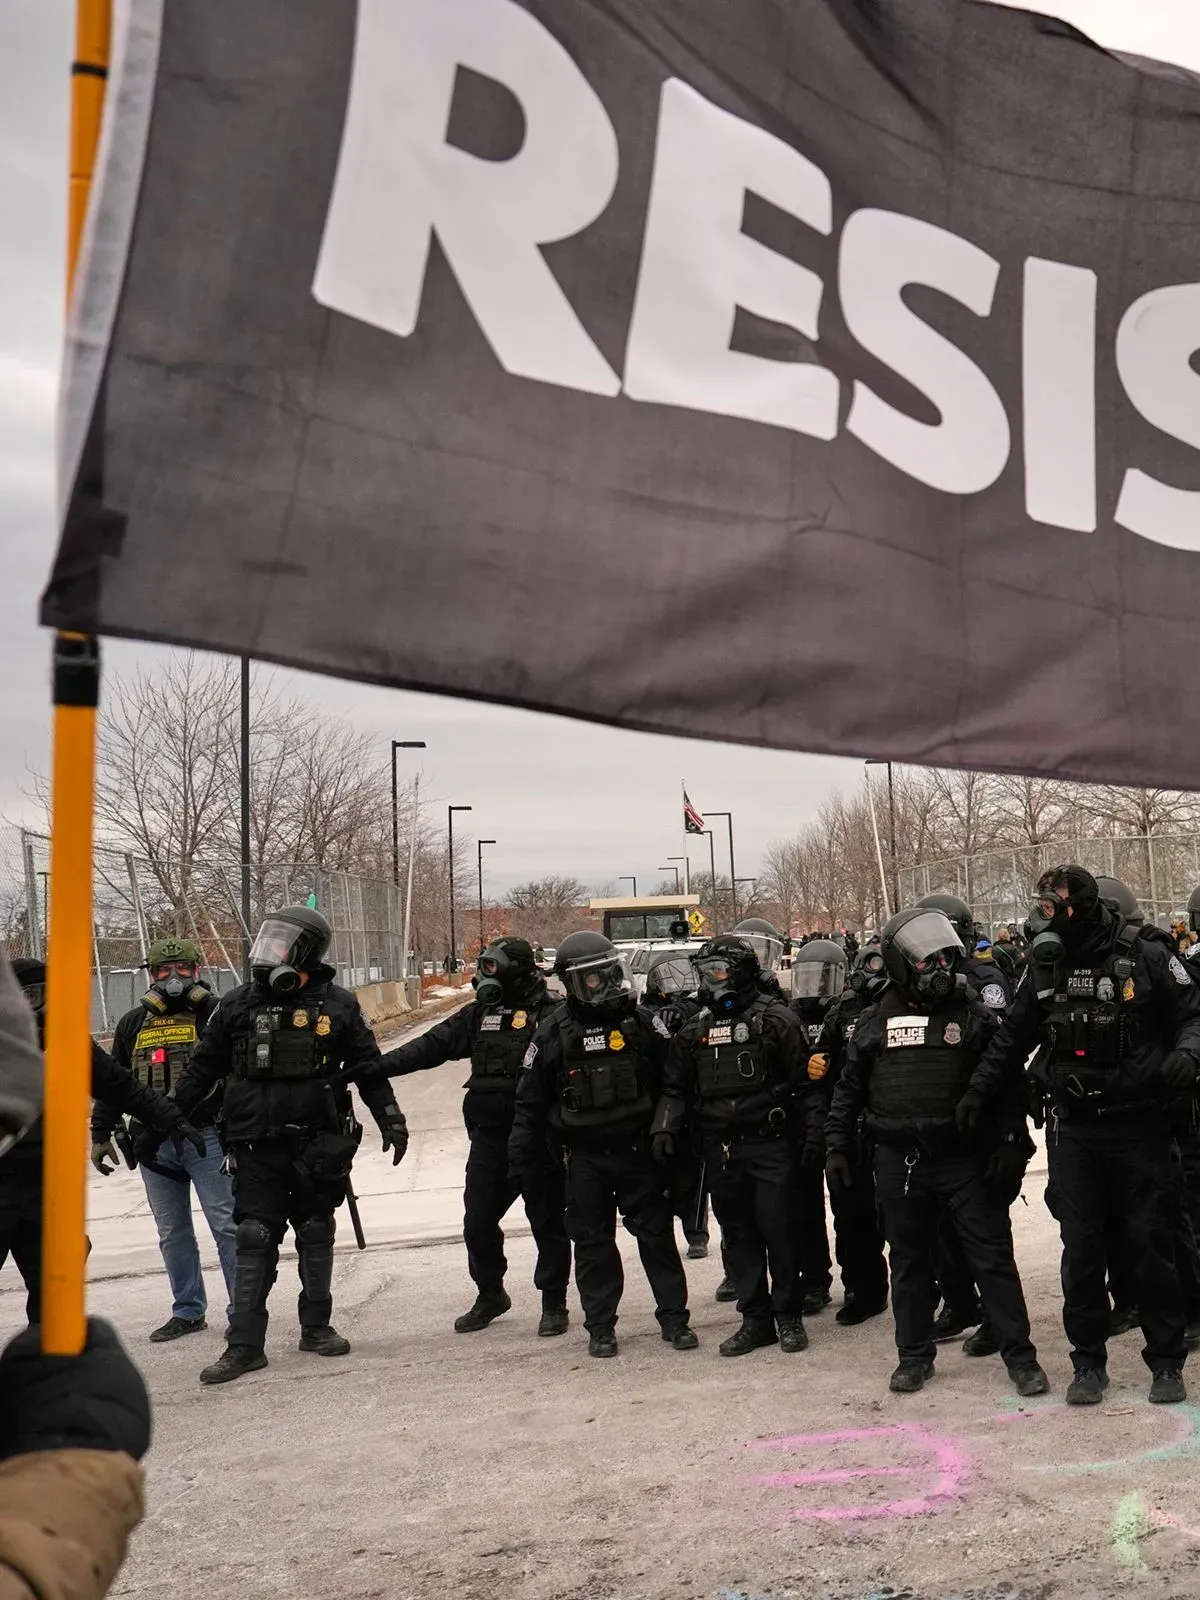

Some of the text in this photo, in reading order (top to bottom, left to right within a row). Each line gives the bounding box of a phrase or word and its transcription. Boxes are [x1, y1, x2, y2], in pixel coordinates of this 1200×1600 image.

[1068, 978, 1094, 987] POLICE
[140, 1028, 191, 1040] FEDERAL OFFICER
[709, 1026, 732, 1038] POLICE
[887, 1027, 925, 1039] POLICE
[583, 1035, 606, 1046] POLICE
